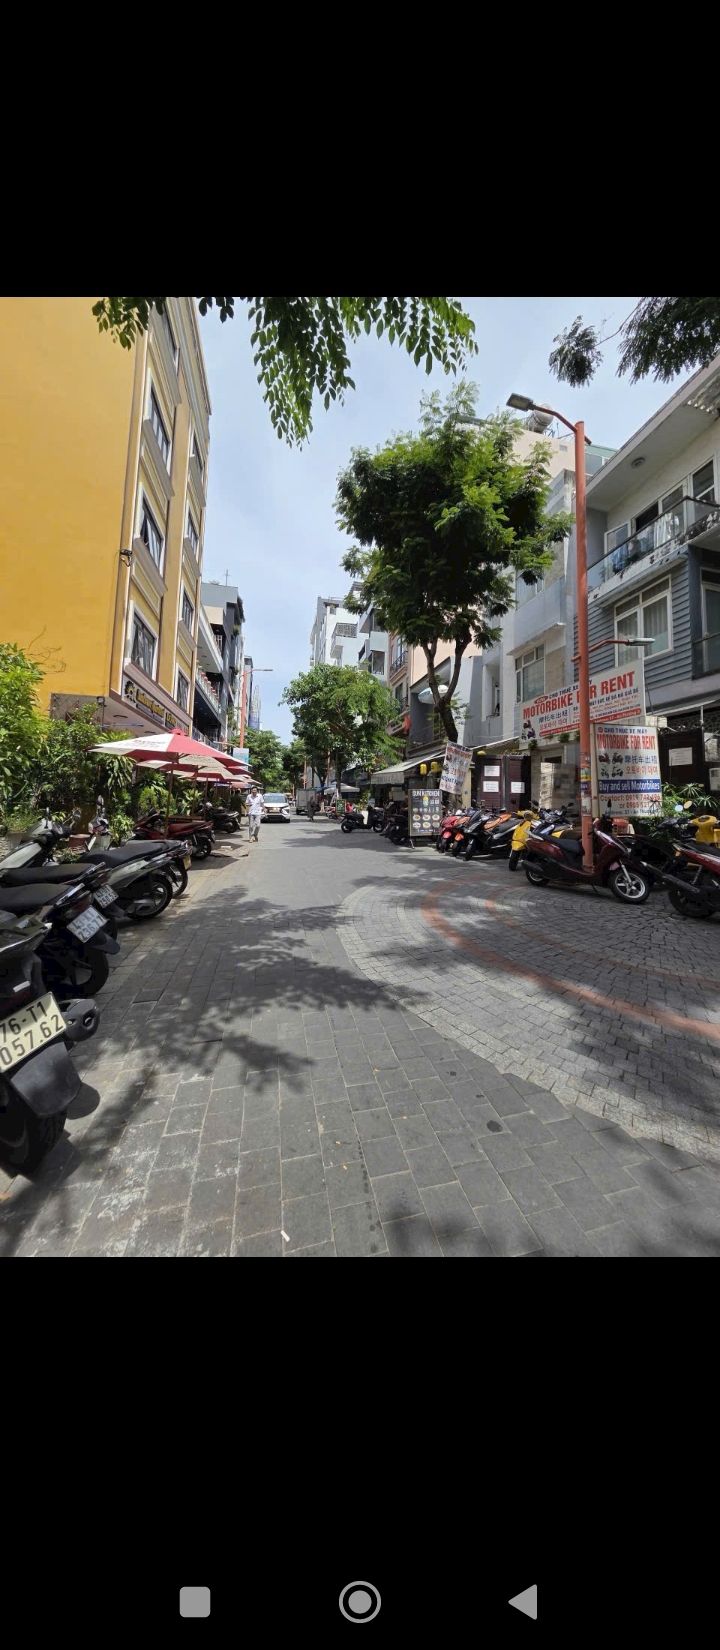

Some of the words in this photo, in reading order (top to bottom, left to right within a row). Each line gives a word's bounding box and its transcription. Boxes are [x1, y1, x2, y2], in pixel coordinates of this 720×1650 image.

[523, 692, 573, 719] MOTORBIKE
[601, 671, 635, 696] RENT
[597, 734, 630, 750] MOTORBIKE
[630, 735, 640, 750] FOR
[642, 735, 656, 750] RENT
[600, 781, 611, 792] Buy
[611, 781, 621, 790] and
[621, 781, 630, 790] sell
[631, 780, 660, 790] Motorbikes
[0, 1001, 47, 1043] 76-T1
[0, 1015, 63, 1066] 057.62
